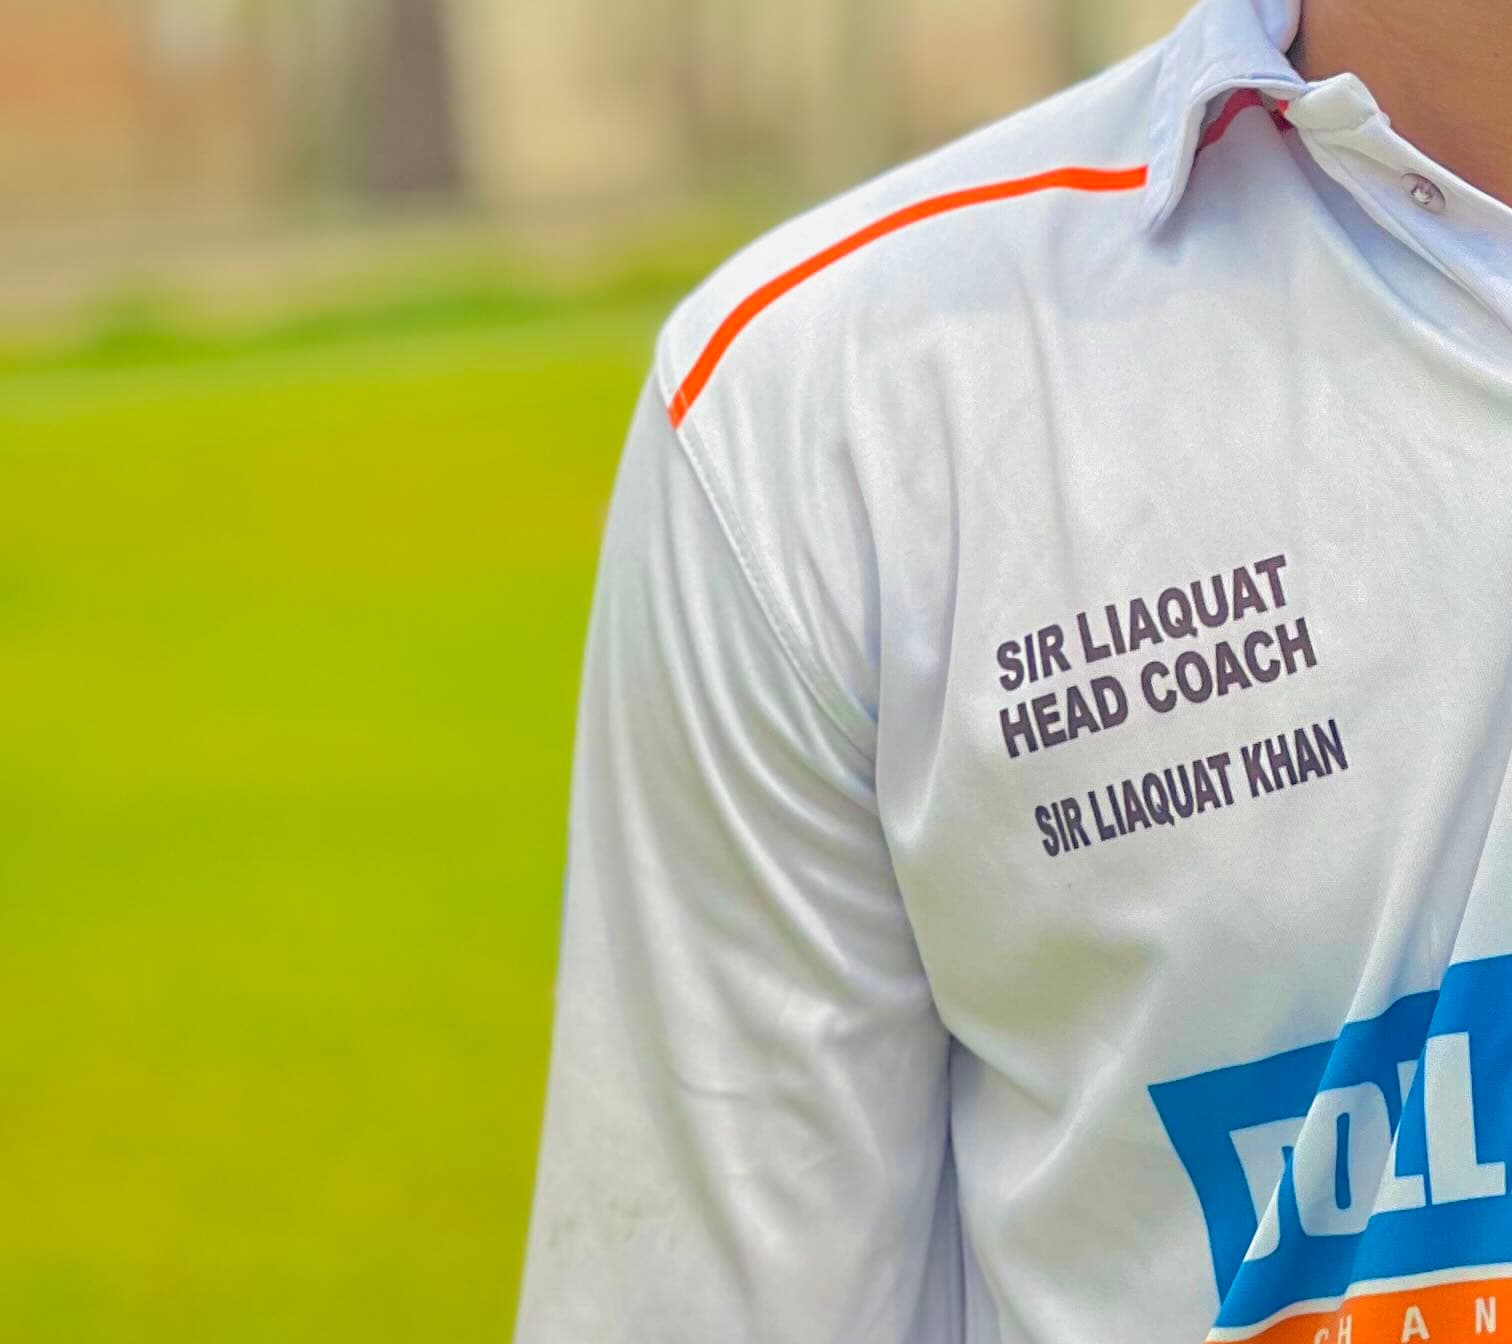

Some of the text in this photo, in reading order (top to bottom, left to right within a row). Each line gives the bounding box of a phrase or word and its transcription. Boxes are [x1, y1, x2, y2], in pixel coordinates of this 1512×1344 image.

[996, 554, 1287, 691] SIR LIAQUAT
[999, 617, 1318, 758] HEAD COACH
[1034, 719, 1349, 857] SIR LIAQUAT KHAN
